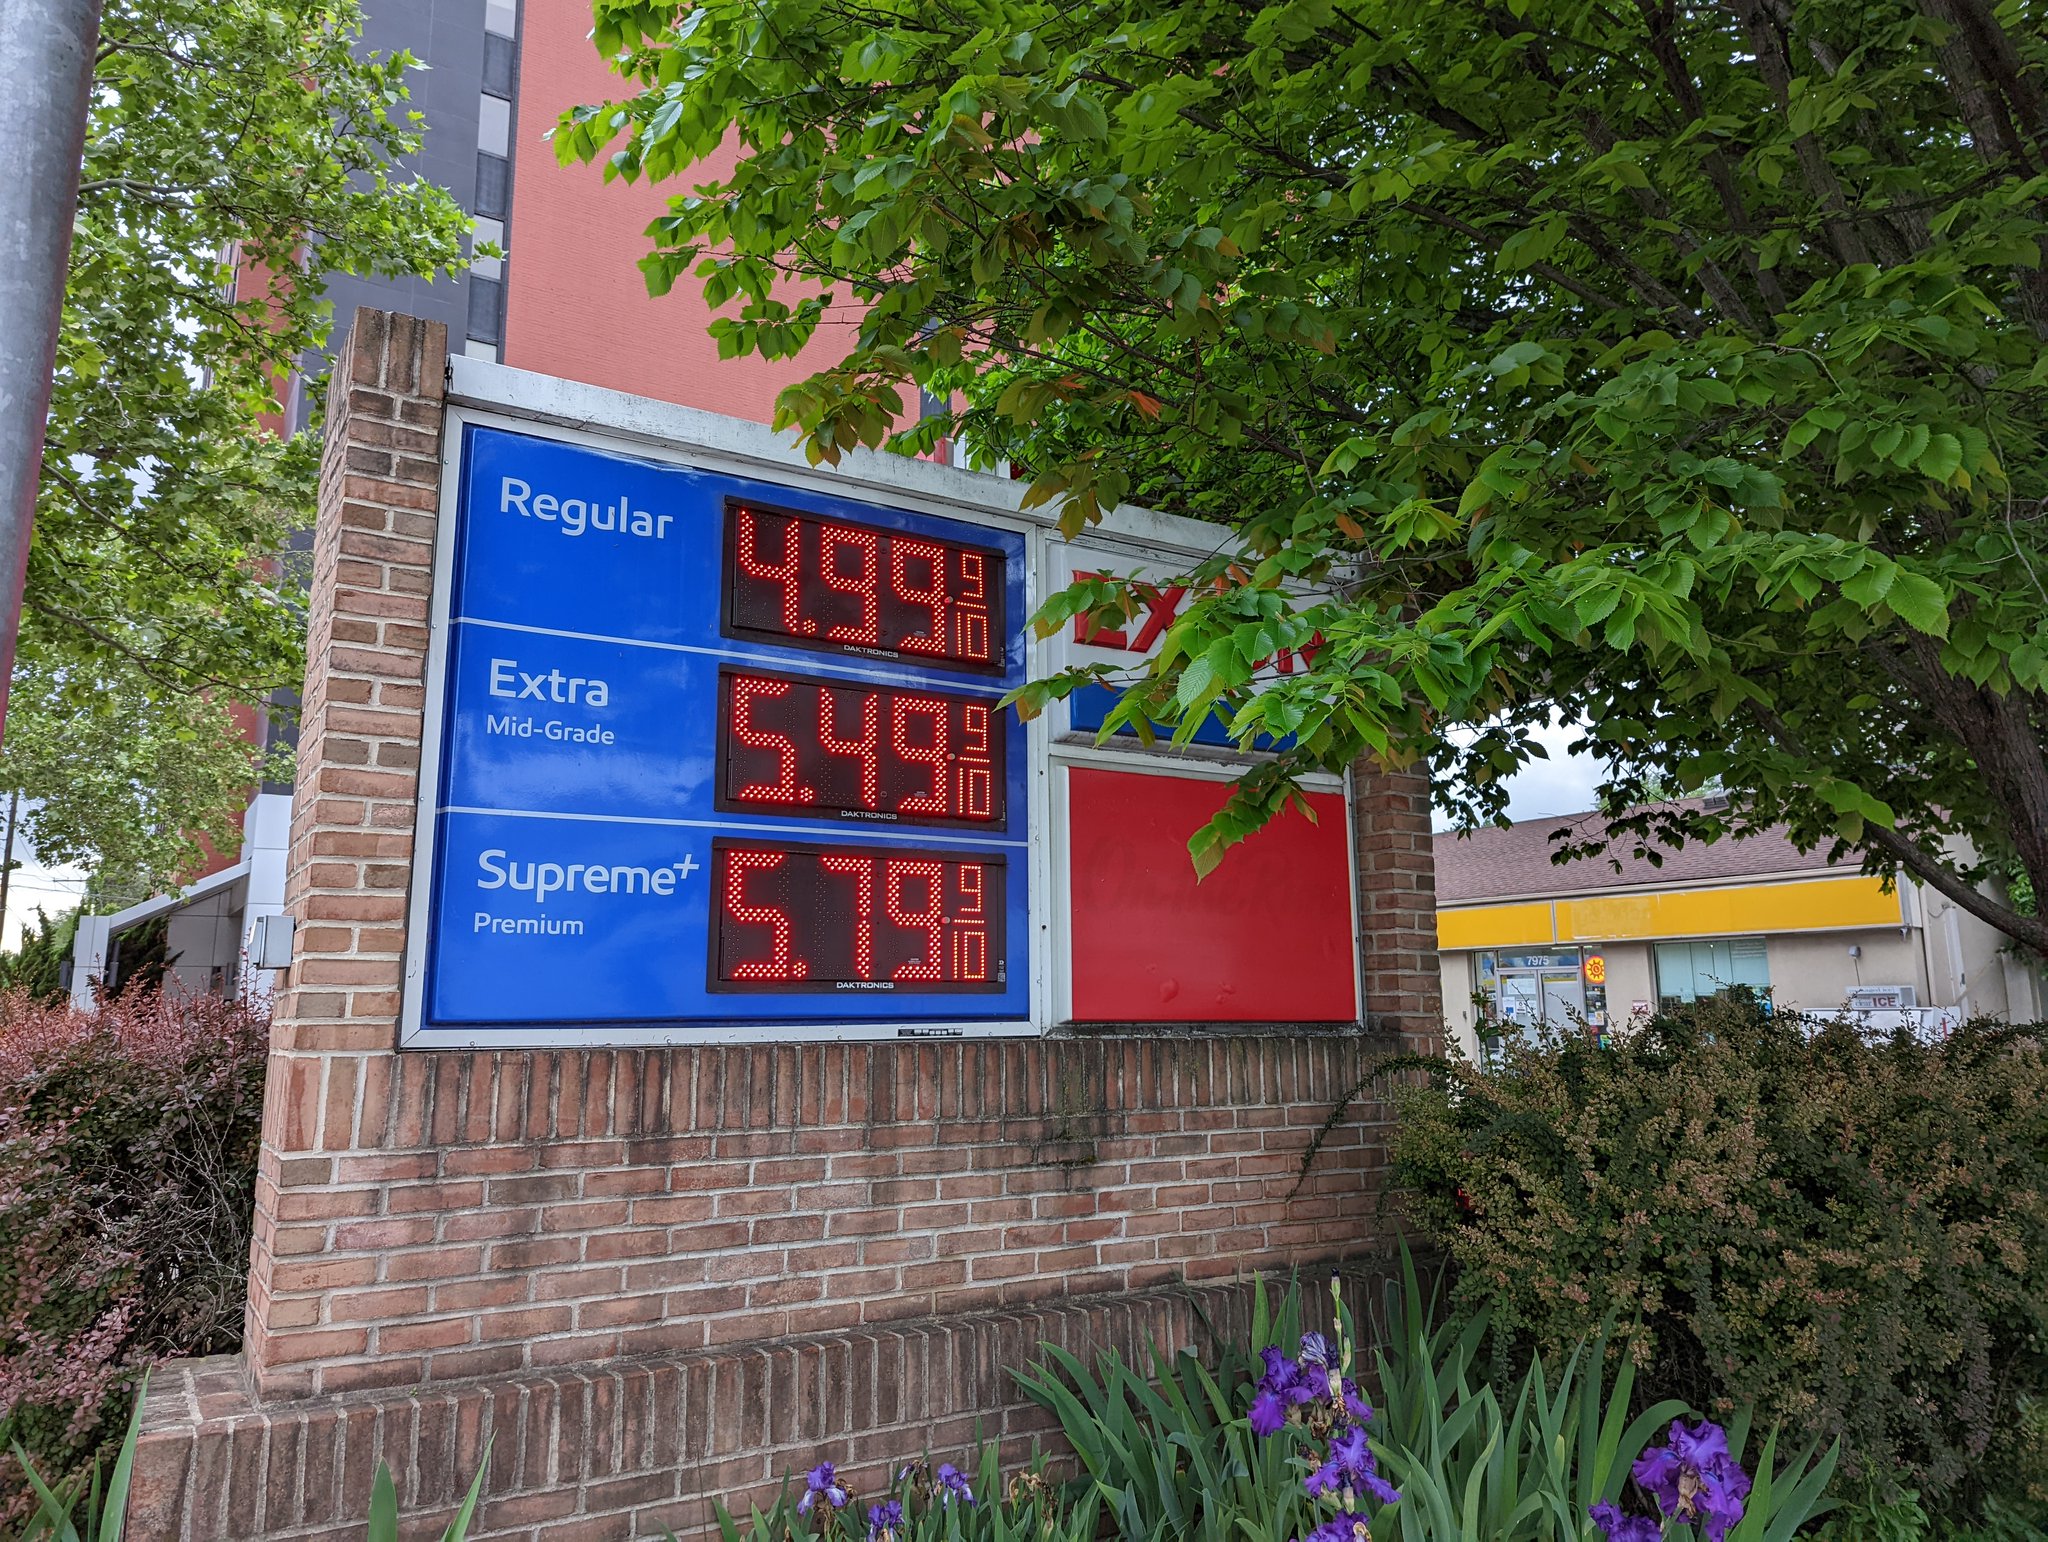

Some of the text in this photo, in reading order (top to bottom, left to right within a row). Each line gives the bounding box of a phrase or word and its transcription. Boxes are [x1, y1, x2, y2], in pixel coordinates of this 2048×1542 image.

[500, 476, 674, 539] Regular
[739, 509, 947, 654] 4.99
[843, 644, 899, 658] DAKTRONICS
[489, 657, 609, 707] Extra
[486, 714, 615, 745] Mid-Grade
[735, 677, 948, 813] 5.49
[840, 809, 898, 820] DAKTRONICS
[473, 912, 584, 935] Premium
[728, 852, 943, 979] 5.79
[1526, 955, 1550, 966] 7975
[836, 981, 895, 990] DAKTRONICS
[1872, 996, 1897, 1007] ICE
